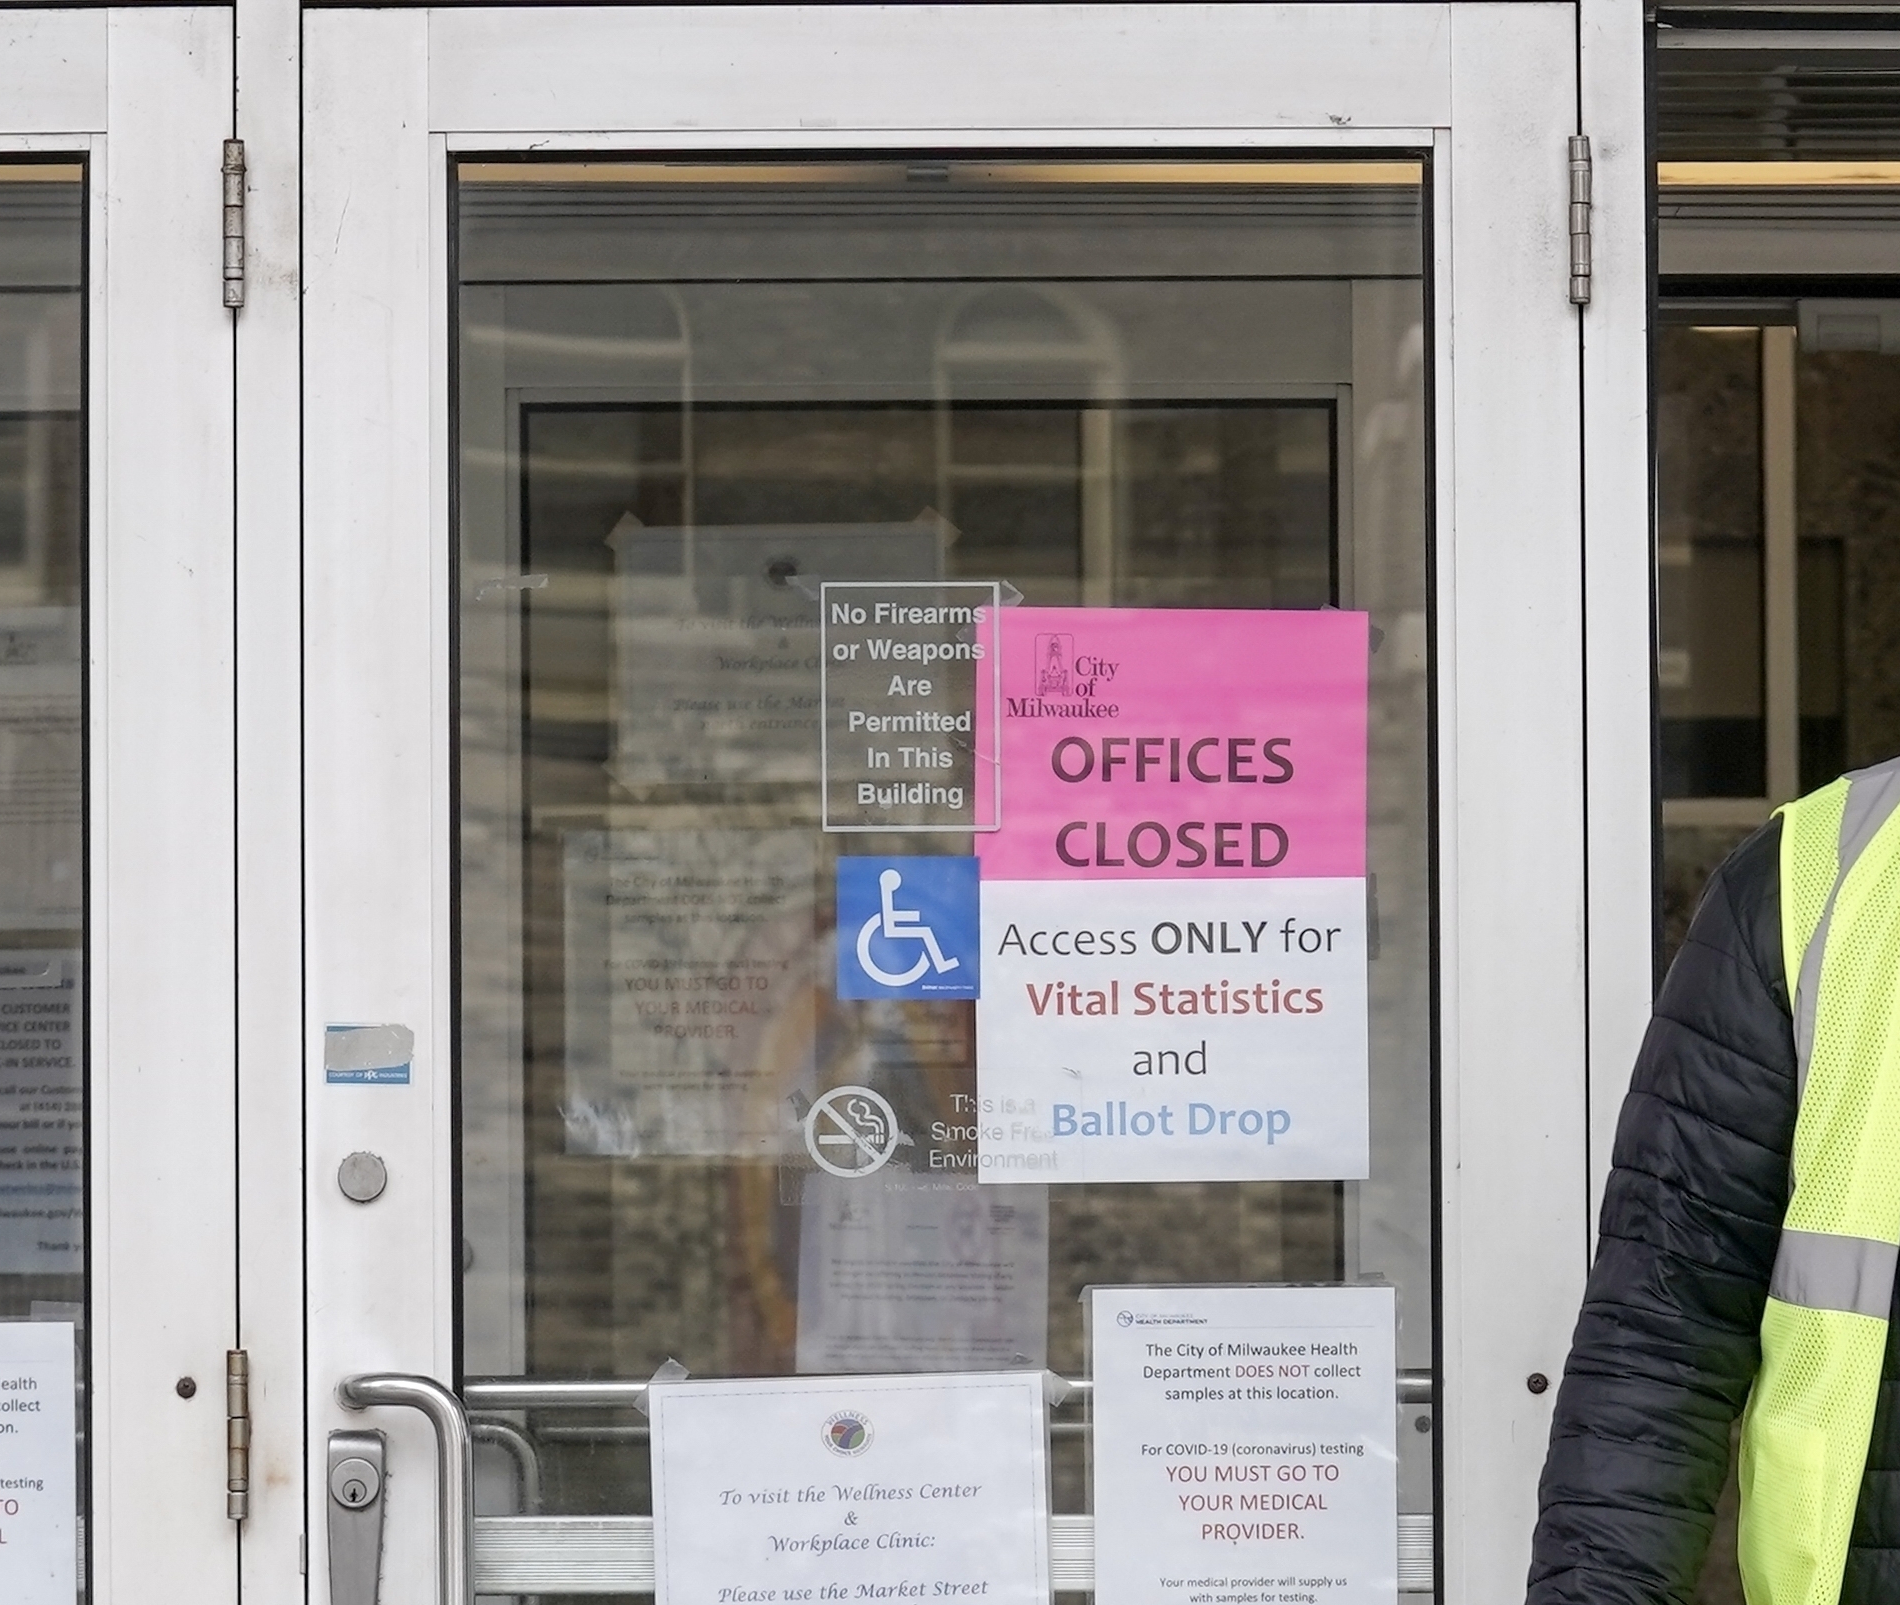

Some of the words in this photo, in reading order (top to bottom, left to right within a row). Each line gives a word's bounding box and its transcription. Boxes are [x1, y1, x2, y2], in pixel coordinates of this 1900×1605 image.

[832, 603, 866, 624] No
[875, 603, 987, 624] Firearms
[833, 644, 860, 660] or
[867, 639, 986, 662] Weapons
[1076, 656, 1119, 681] City
[888, 675, 931, 696] Are
[1076, 677, 1097, 697] of
[1006, 698, 1118, 718] Milwaukee
[850, 711, 970, 732] Permitted
[868, 748, 889, 768] In
[898, 747, 953, 767] This
[1052, 736, 1293, 784] OFFICES
[858, 783, 963, 809] Building
[1056, 822, 1289, 868] CLOSED
[998, 924, 1136, 955] Access
[1152, 921, 1267, 954] ONLY
[1280, 918, 1341, 953] for
[1026, 981, 1118, 1015] Vital
[1134, 979, 1323, 1015] Statistics
[1133, 1040, 1206, 1075] and
[931, 1121, 1003, 1141] Smoke
[1052, 1101, 1174, 1137] Ballot
[1189, 1103, 1291, 1145] Drop
[929, 1149, 1059, 1170] Environment
[720, 1489, 742, 1505] To
[748, 1489, 788, 1503] visit
[798, 1486, 825, 1502] the
[832, 1484, 913, 1501] Wellness
[920, 1484, 982, 1499] Center
[844, 1511, 858, 1525] &
[768, 1534, 869, 1556] Workplace
[877, 1532, 935, 1549] Clinic:
[719, 1586, 776, 1602] Please
[784, 1589, 812, 1600] use
[820, 1583, 848, 1599] the
[854, 1580, 926, 1598] Market
[933, 1581, 988, 1596] Street
